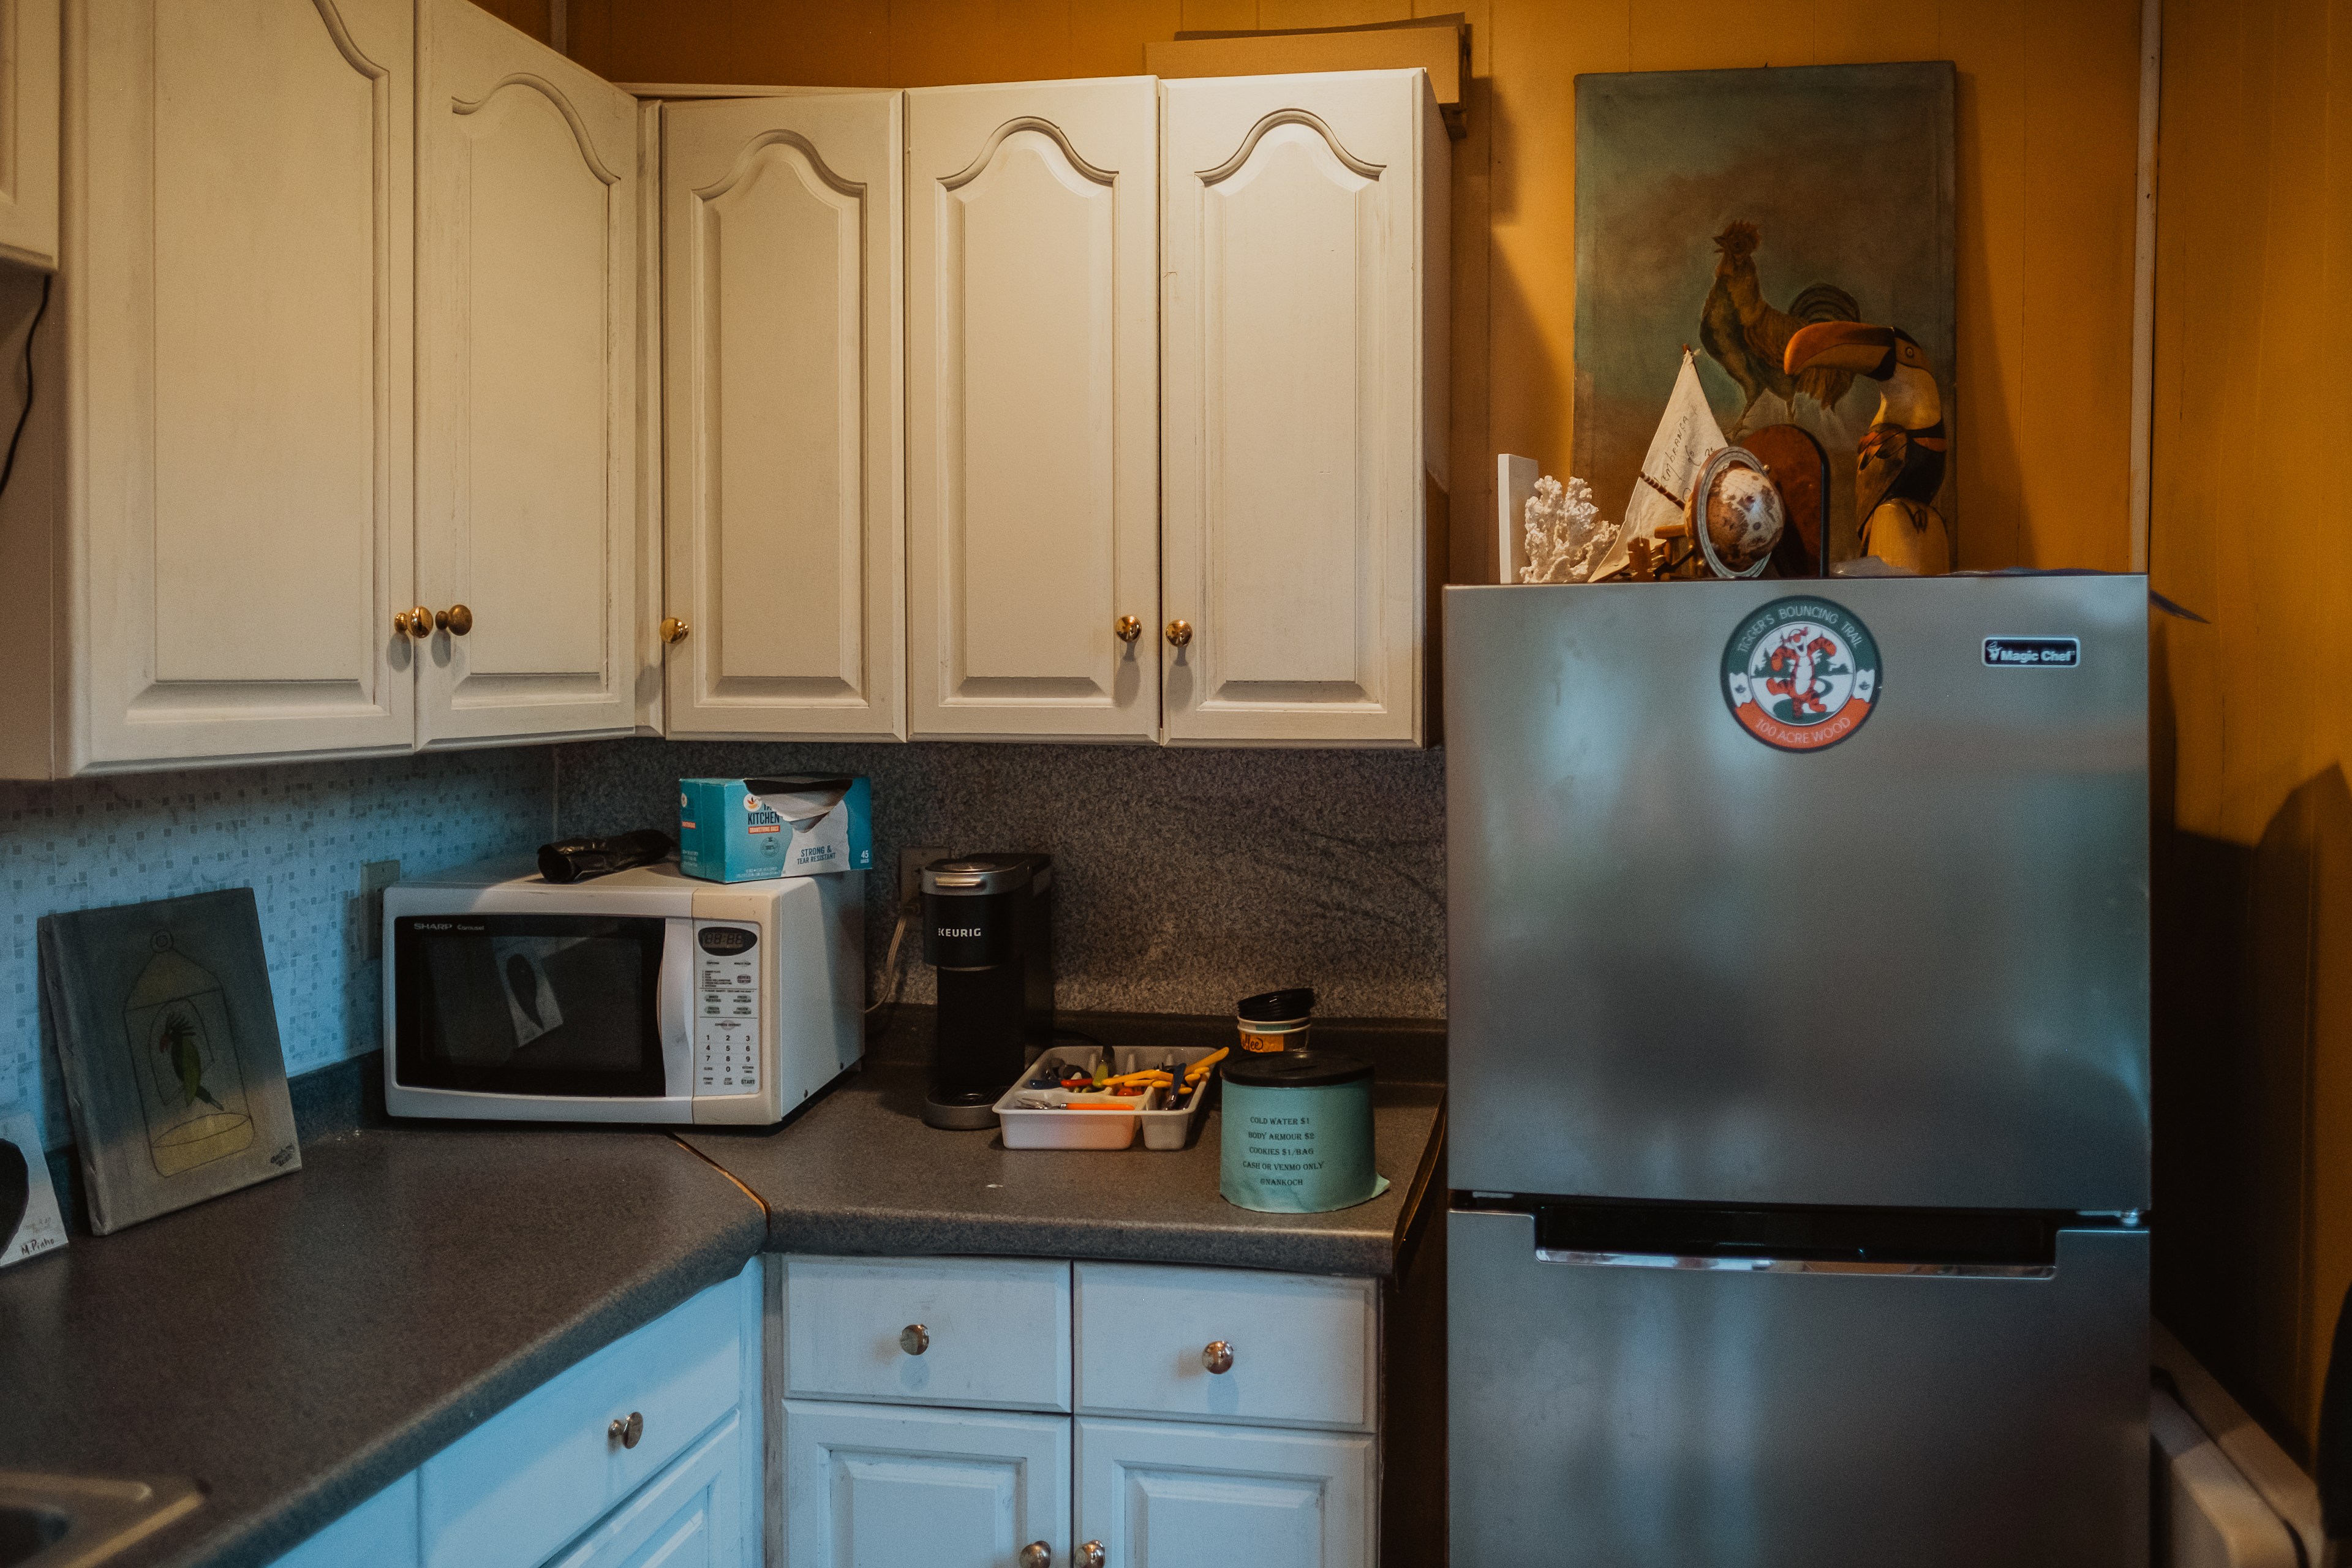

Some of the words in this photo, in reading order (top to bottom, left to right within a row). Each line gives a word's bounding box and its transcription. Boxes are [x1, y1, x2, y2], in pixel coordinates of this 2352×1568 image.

[1737, 614, 1775, 652] TIGGER'S
[1779, 605, 1839, 624] BOUNCING
[1841, 621, 1863, 648] TRAIL
[2000, 650, 2040, 663] Magic
[2040, 650, 2072, 662] Chef
[1755, 718, 1777, 736] 100
[1777, 731, 1809, 744] ACRE
[1812, 717, 1851, 742] WOOD
[747, 811, 780, 826] KITCHEN
[801, 846, 825, 858] STRONG
[861, 850, 869, 858] 45
[797, 856, 809, 865] TEAR
[810, 852, 836, 862] RESISTANT
[938, 927, 981, 938] KEURIG
[1249, 1147, 1280, 1156] COOKIES
[1243, 1161, 1261, 1169] CASH
[1303, 1161, 1324, 1170] ONLY
[1260, 1178, 1303, 1186] @NANKOCH
